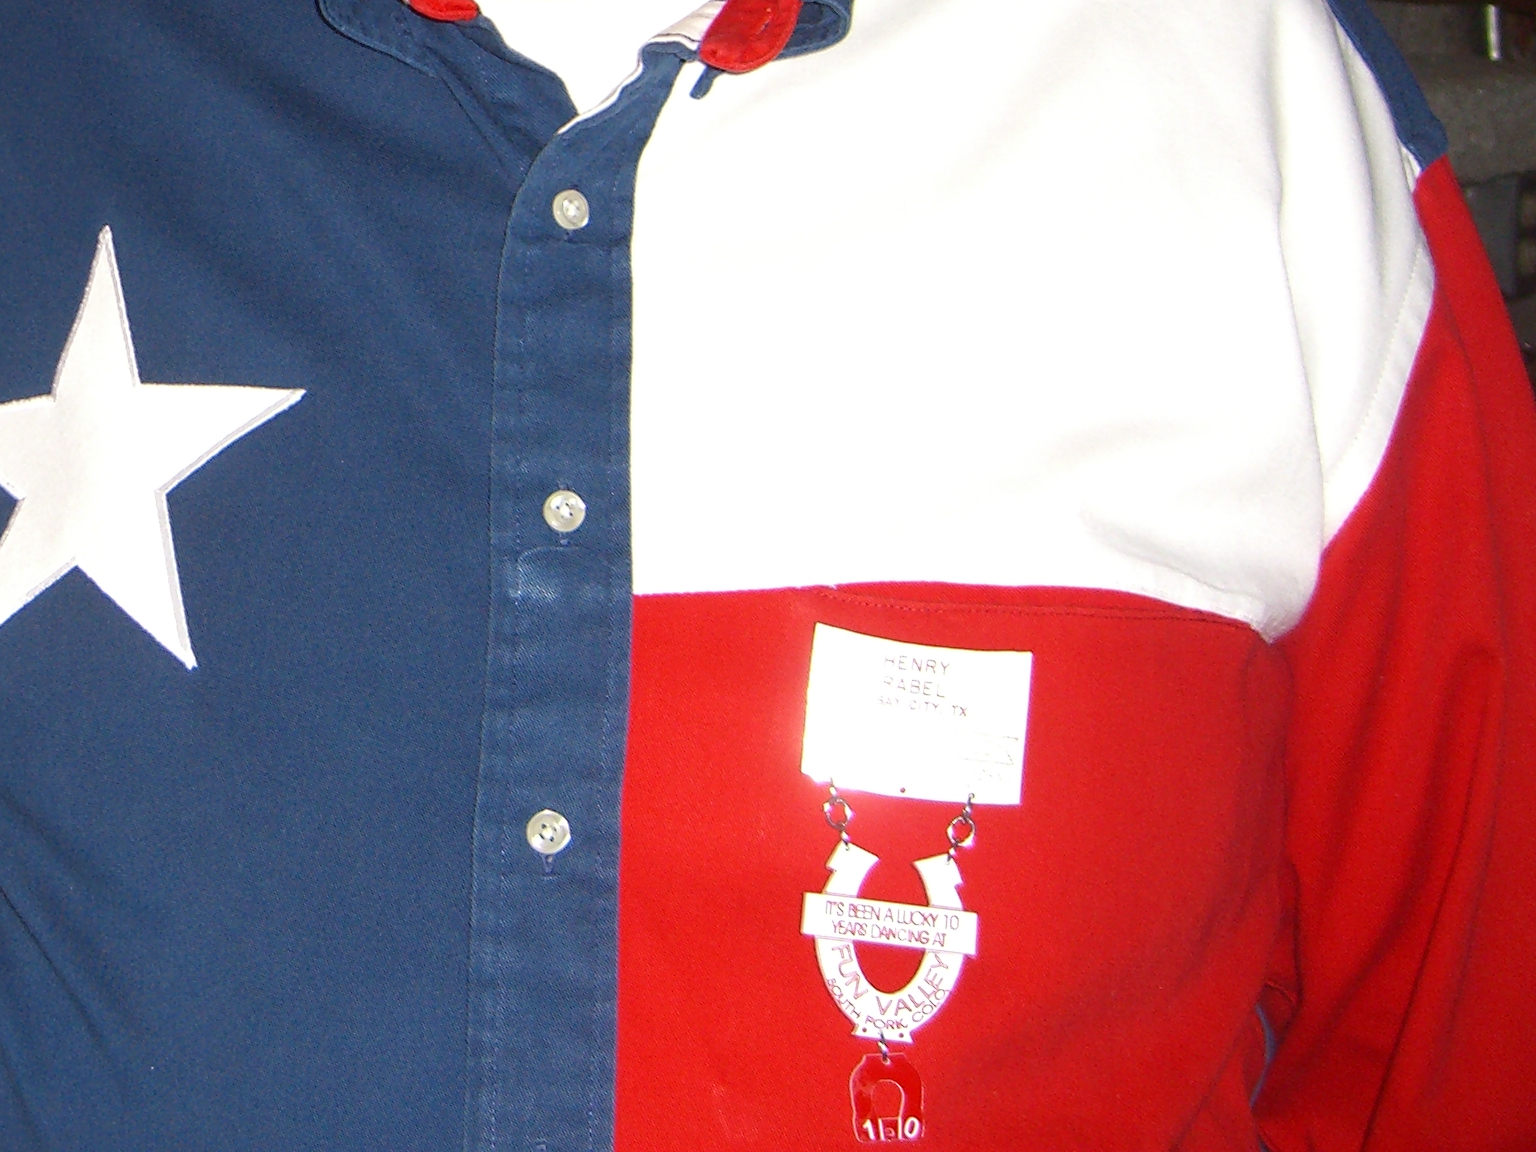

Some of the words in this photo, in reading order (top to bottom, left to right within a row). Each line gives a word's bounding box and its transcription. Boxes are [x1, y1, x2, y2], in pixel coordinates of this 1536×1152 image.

[884, 654, 951, 676] HENRY
[826, 901, 845, 917] IT'S
[848, 903, 880, 922] BEEN
[883, 909, 894, 924] A
[897, 910, 939, 928] LUCKY
[944, 914, 960, 931] 10
[832, 919, 867, 936] YEARS
[871, 925, 930, 945] DANCING
[932, 932, 947, 947] AT
[832, 944, 869, 1000] FUN
[876, 951, 950, 1016] VALLEY
[865, 1014, 908, 1030] FORK
